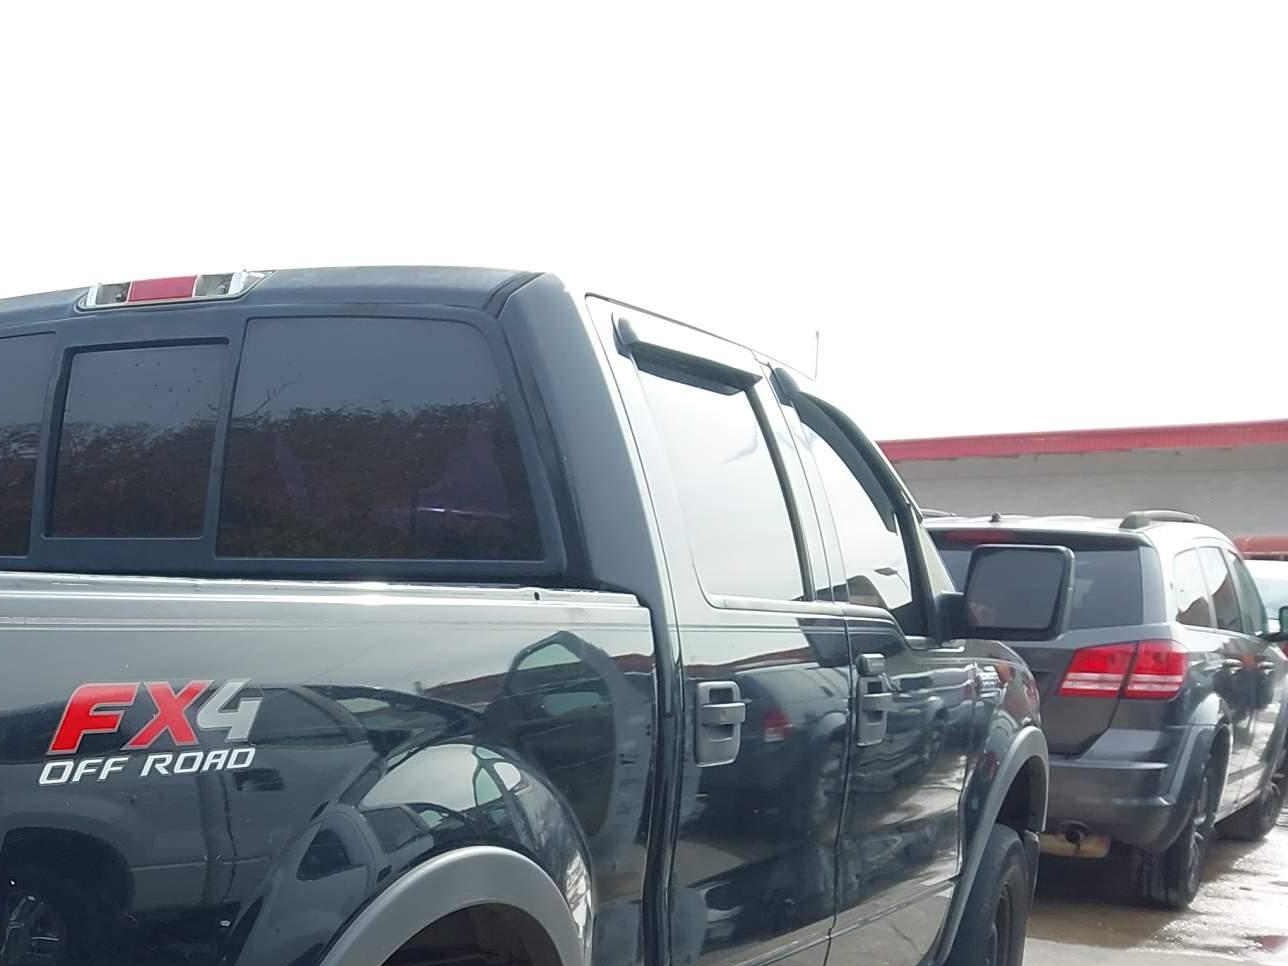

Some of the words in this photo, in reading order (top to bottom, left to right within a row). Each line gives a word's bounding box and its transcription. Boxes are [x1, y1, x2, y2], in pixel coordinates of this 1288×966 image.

[46, 678, 263, 755] FX4
[37, 754, 132, 787] OFF
[139, 745, 257, 778] ROAD
